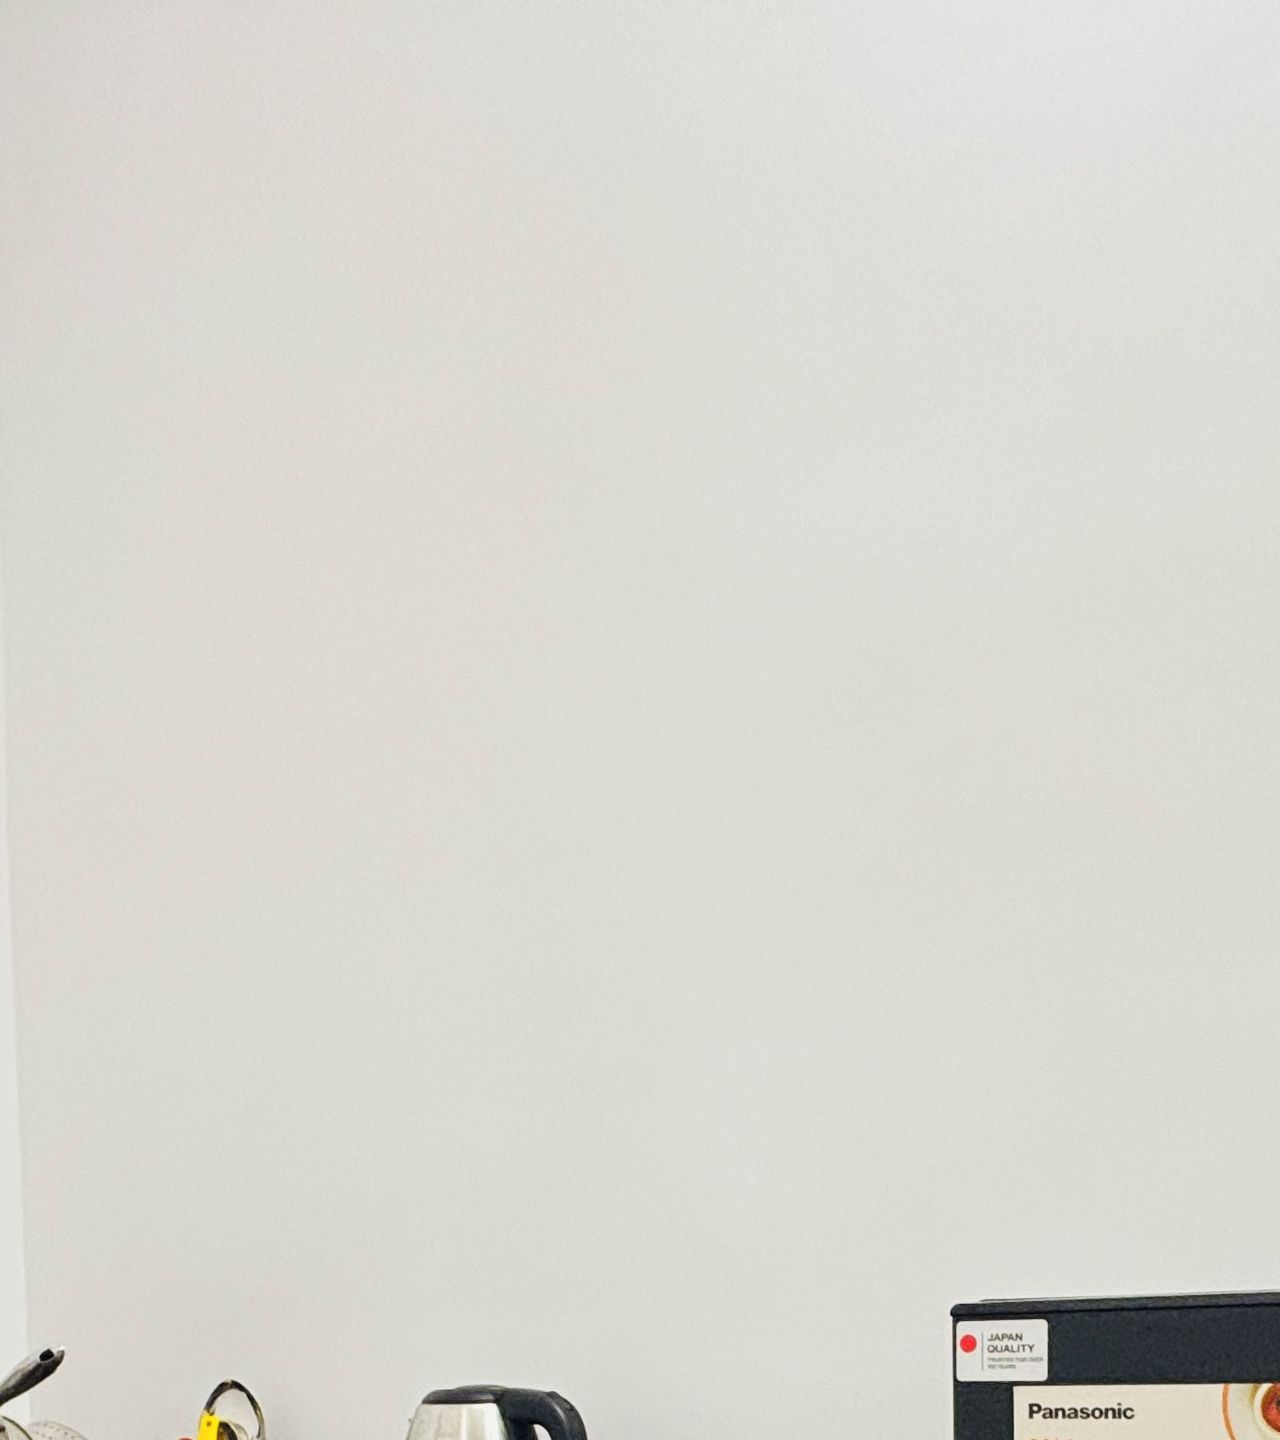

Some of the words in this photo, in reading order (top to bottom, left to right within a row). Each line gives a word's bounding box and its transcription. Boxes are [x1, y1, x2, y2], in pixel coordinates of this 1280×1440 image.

[987, 1333, 1023, 1342] JAPAN
[987, 1344, 1035, 1353] QUALITY
[1028, 1402, 1135, 1420] Panasonic
